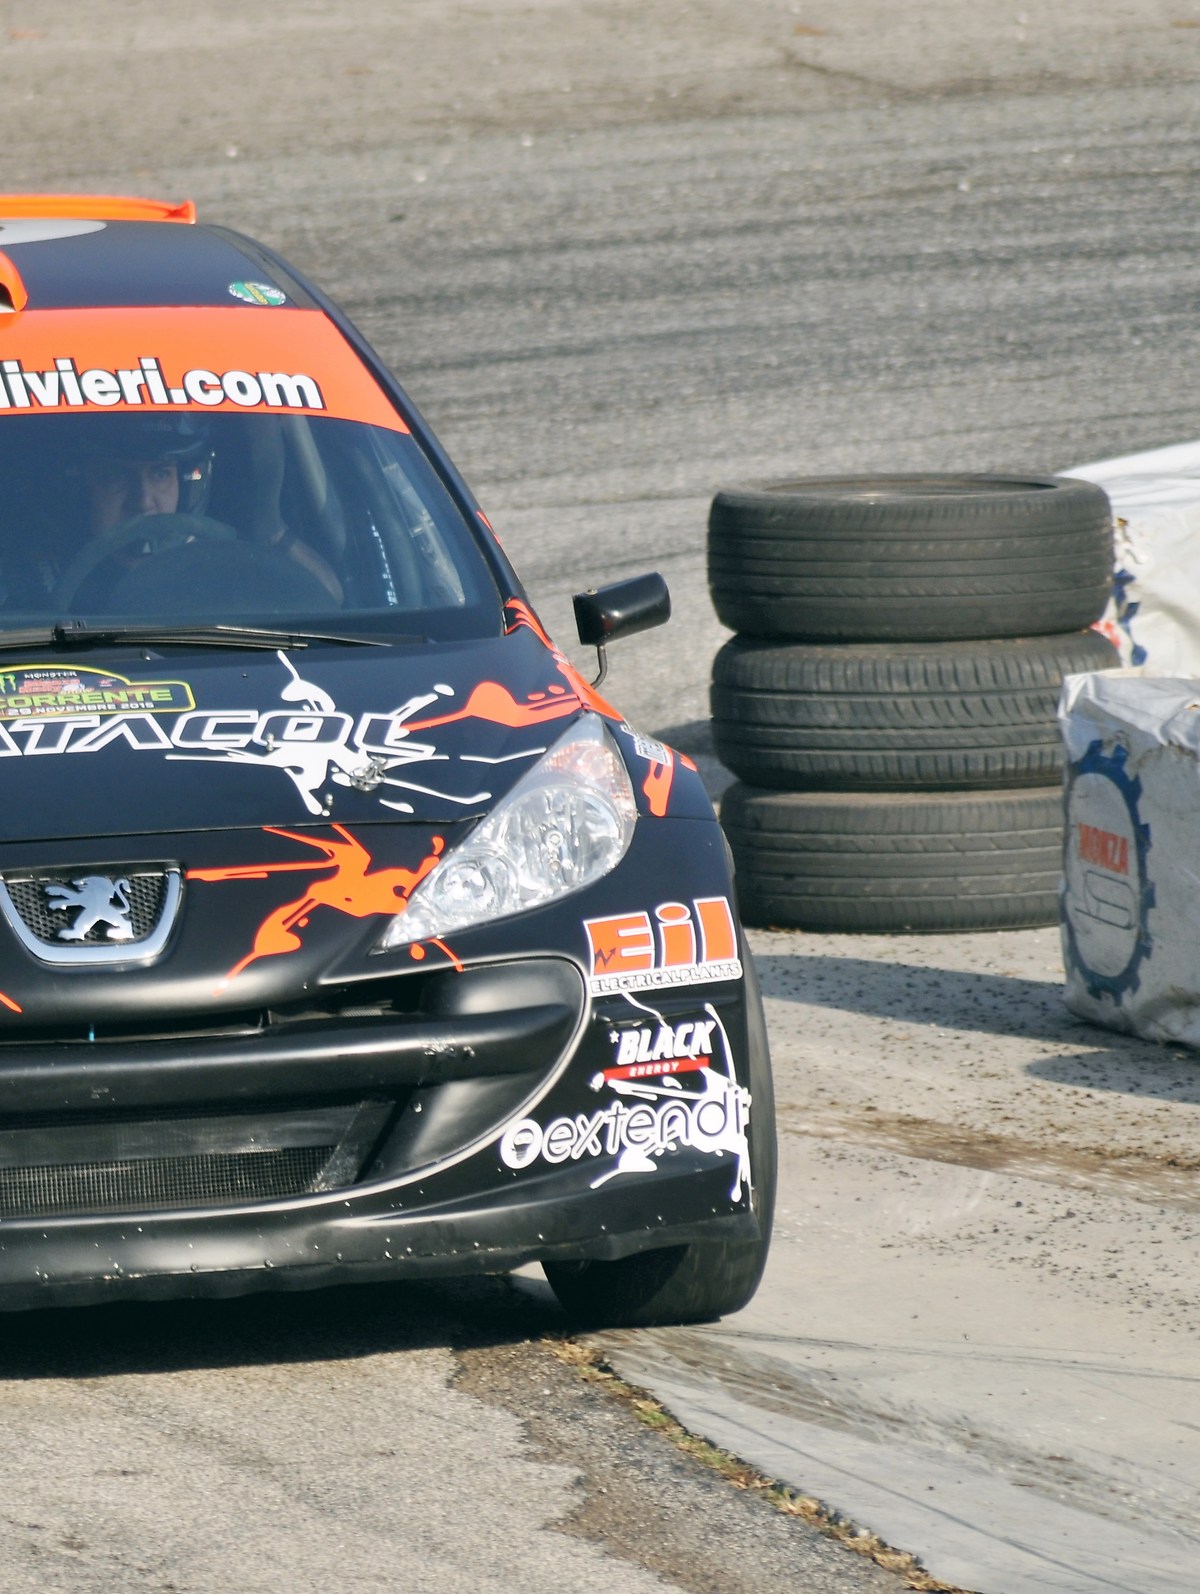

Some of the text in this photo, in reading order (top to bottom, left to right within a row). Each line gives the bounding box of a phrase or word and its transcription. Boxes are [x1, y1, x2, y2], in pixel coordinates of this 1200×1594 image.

[24, 671, 78, 680] MONSTER
[36, 703, 117, 714] NOVEMBRE
[121, 702, 155, 710] 2015
[1078, 821, 1130, 877] MONZA
[583, 896, 739, 977] Eil
[617, 1020, 717, 1066] BLACK
[629, 1061, 681, 1077] ENERGY
[542, 1086, 746, 1164] extendi
